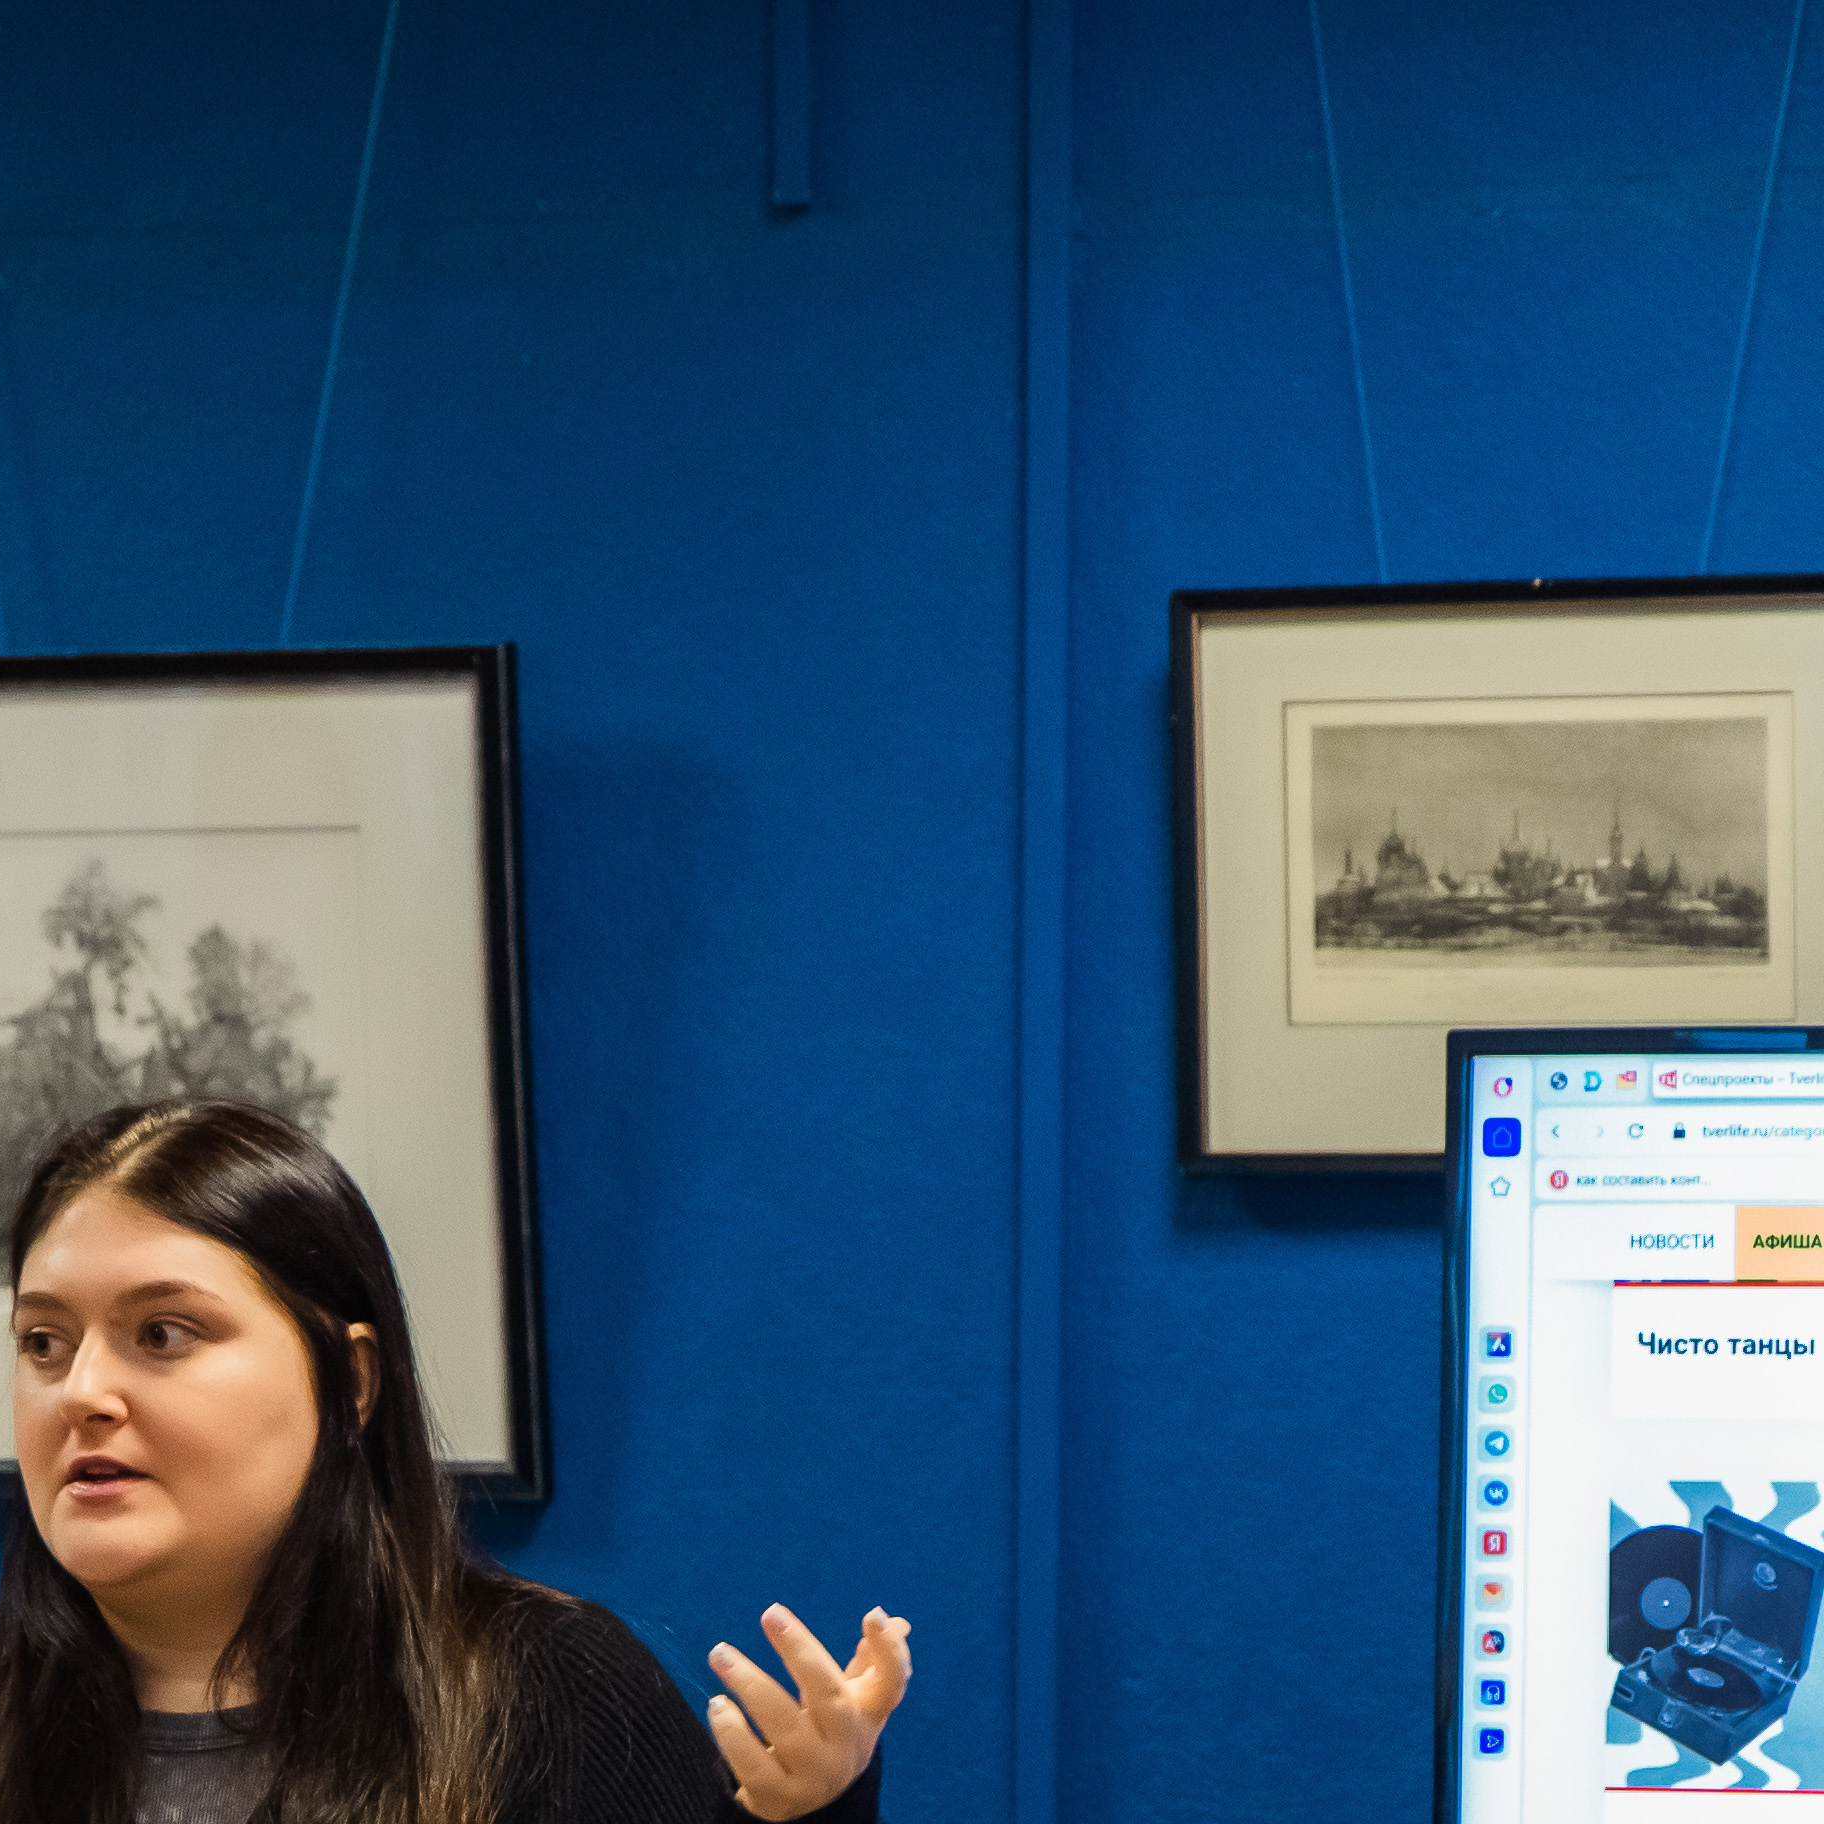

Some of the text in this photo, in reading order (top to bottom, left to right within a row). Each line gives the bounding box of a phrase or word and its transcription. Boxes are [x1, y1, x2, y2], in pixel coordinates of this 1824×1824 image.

[1683, 1072, 1774, 1089] Спецпроекты
[1576, 1175, 1597, 1186] как
[1602, 1175, 1667, 1186] составить
[1629, 1234, 1715, 1250] НОВОСТИ
[1753, 1234, 1823, 1249] АФИША
[1638, 1332, 1815, 1360] Чисто танцы
